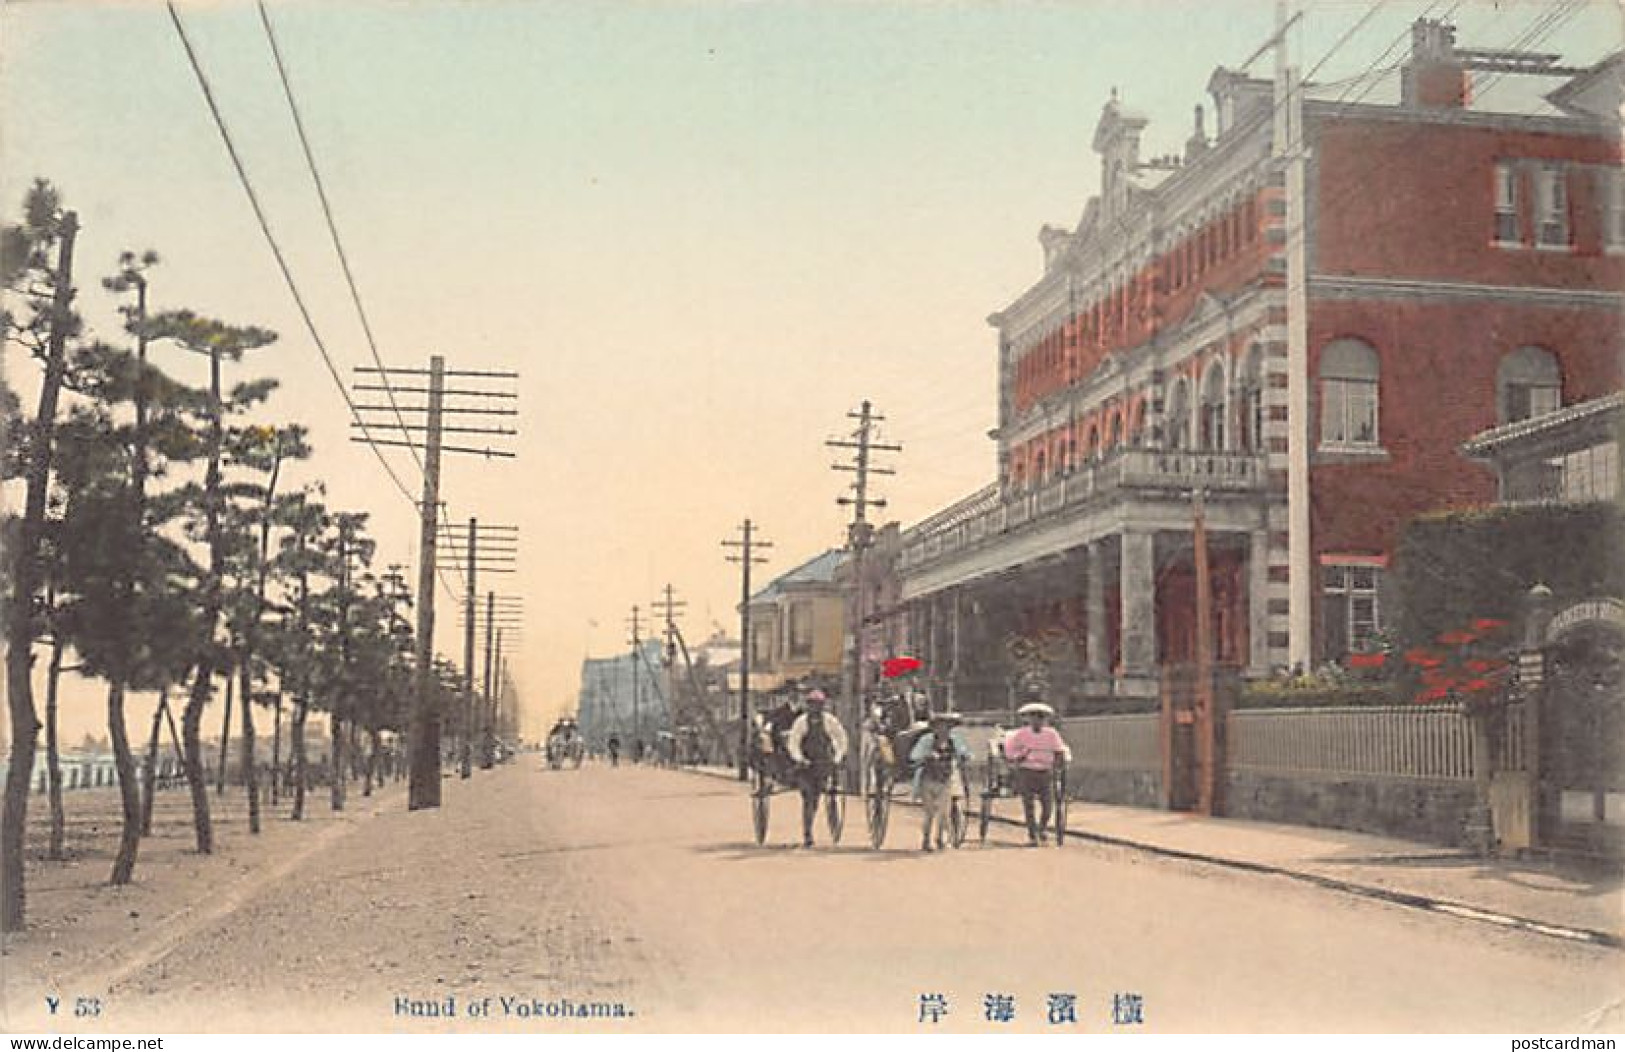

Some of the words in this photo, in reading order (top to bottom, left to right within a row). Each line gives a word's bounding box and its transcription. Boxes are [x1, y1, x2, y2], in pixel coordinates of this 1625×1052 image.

[45, 996, 60, 1014] Y
[74, 997, 101, 1017] 53
[467, 997, 492, 1017] of
[499, 996, 635, 1018] Yokohama.
